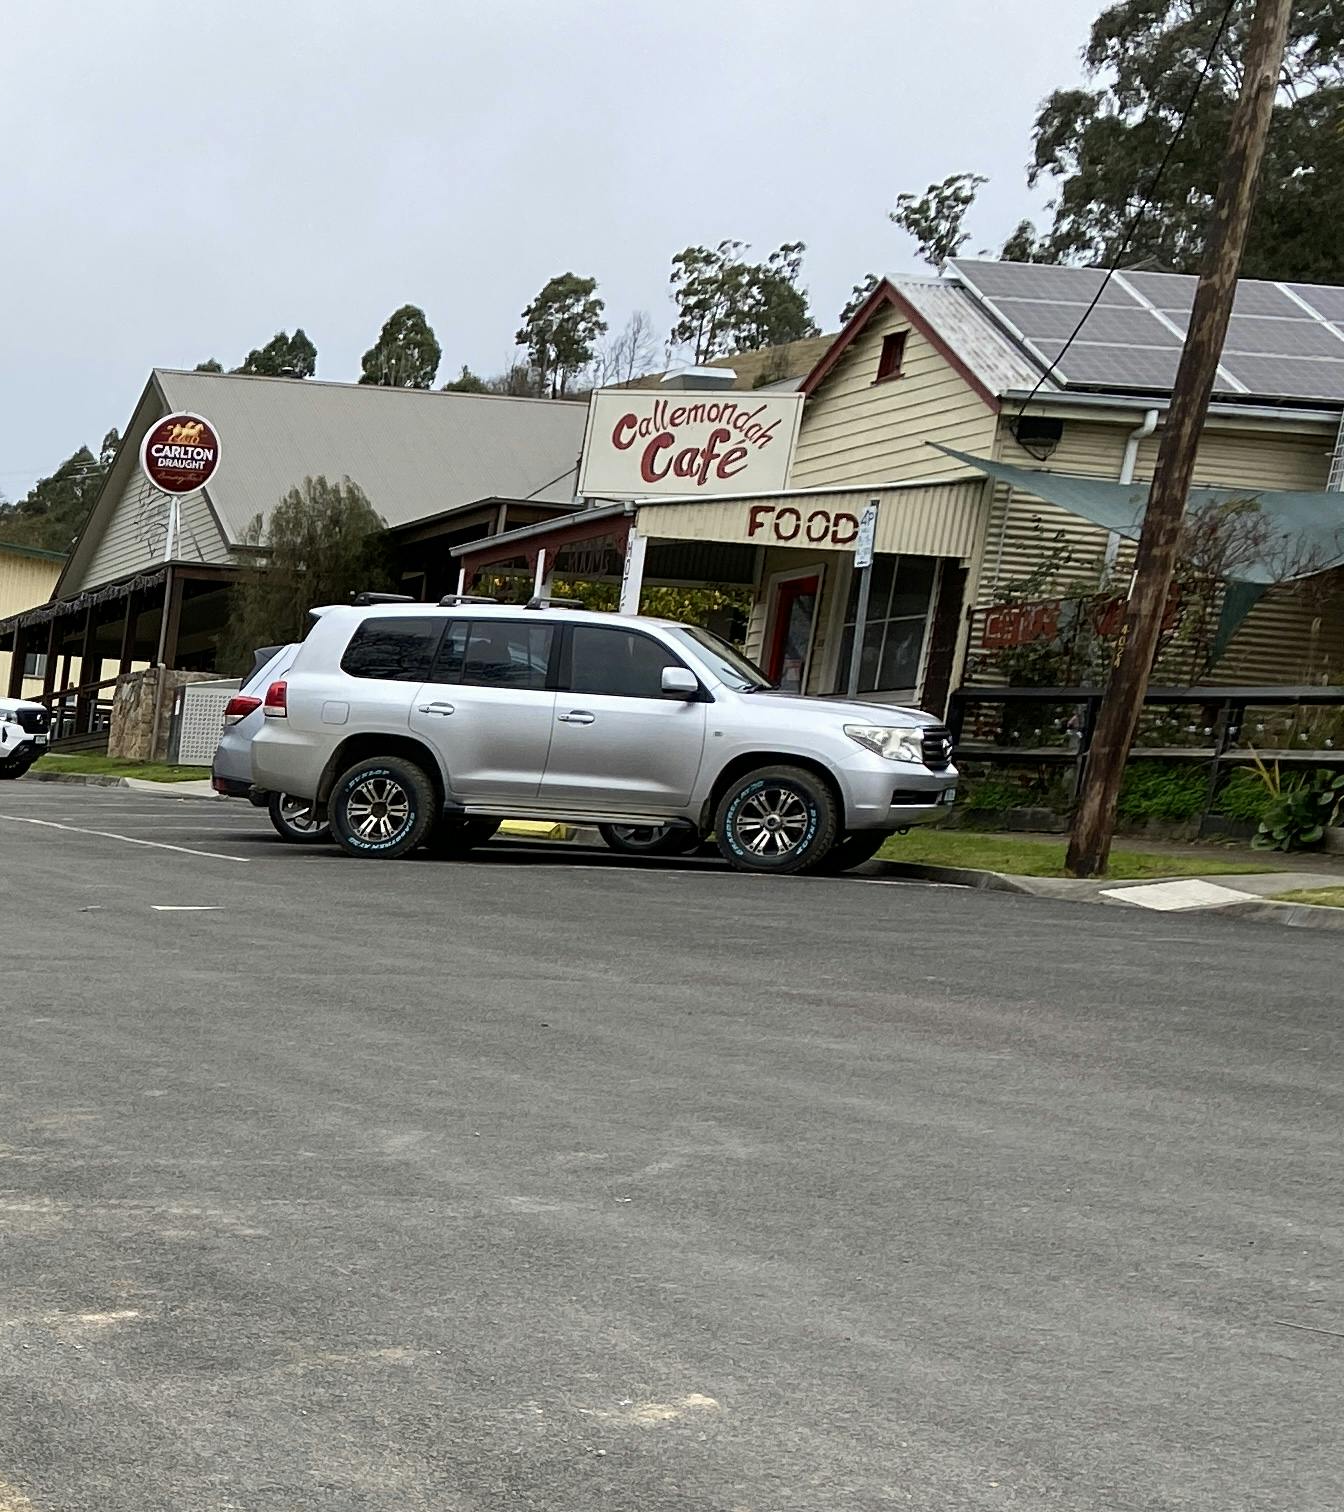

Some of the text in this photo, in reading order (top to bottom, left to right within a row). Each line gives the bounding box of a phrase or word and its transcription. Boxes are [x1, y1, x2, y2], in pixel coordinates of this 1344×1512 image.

[612, 399, 782, 450] Callemondah
[151, 444, 214, 461] CARLTON
[157, 457, 206, 470] DRAUGHT
[640, 428, 749, 487] Café
[748, 505, 860, 545] FOOD
[348, 769, 390, 787] DUNLOP
[795, 808, 817, 855] DUNLOP
